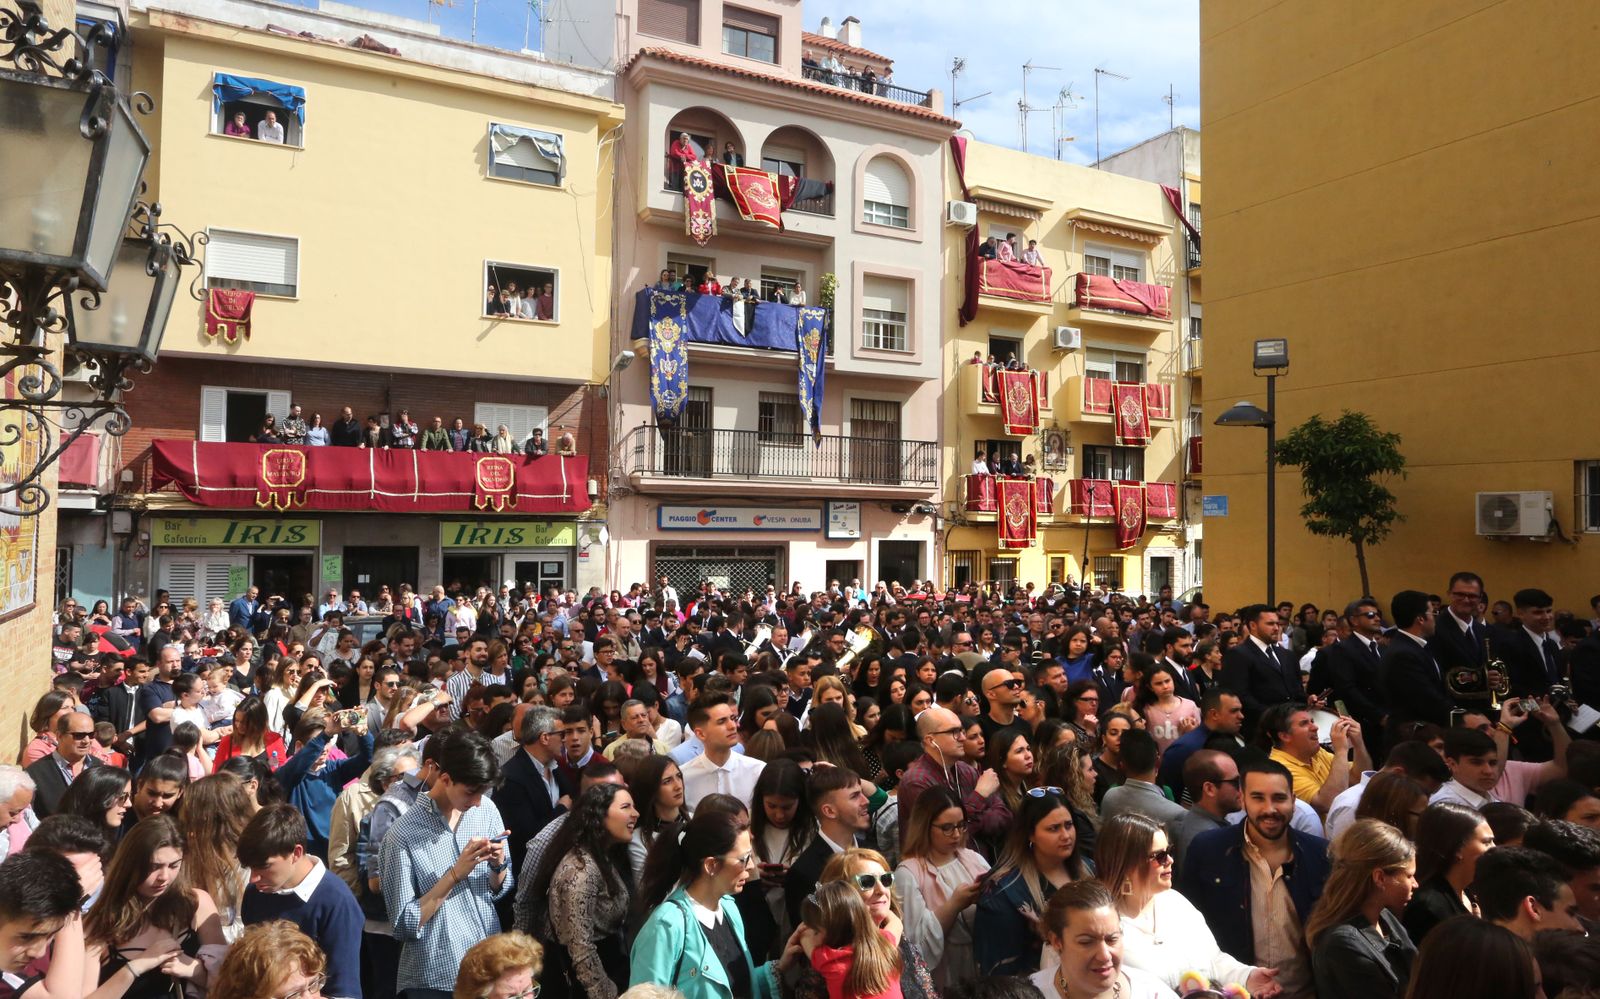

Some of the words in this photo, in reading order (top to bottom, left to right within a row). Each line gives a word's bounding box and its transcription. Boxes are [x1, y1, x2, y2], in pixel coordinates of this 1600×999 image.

[164, 520, 182, 531] Bar
[221, 521, 308, 544] IRIS
[535, 524, 548, 533] Bar
[453, 524, 527, 545] IRIS
